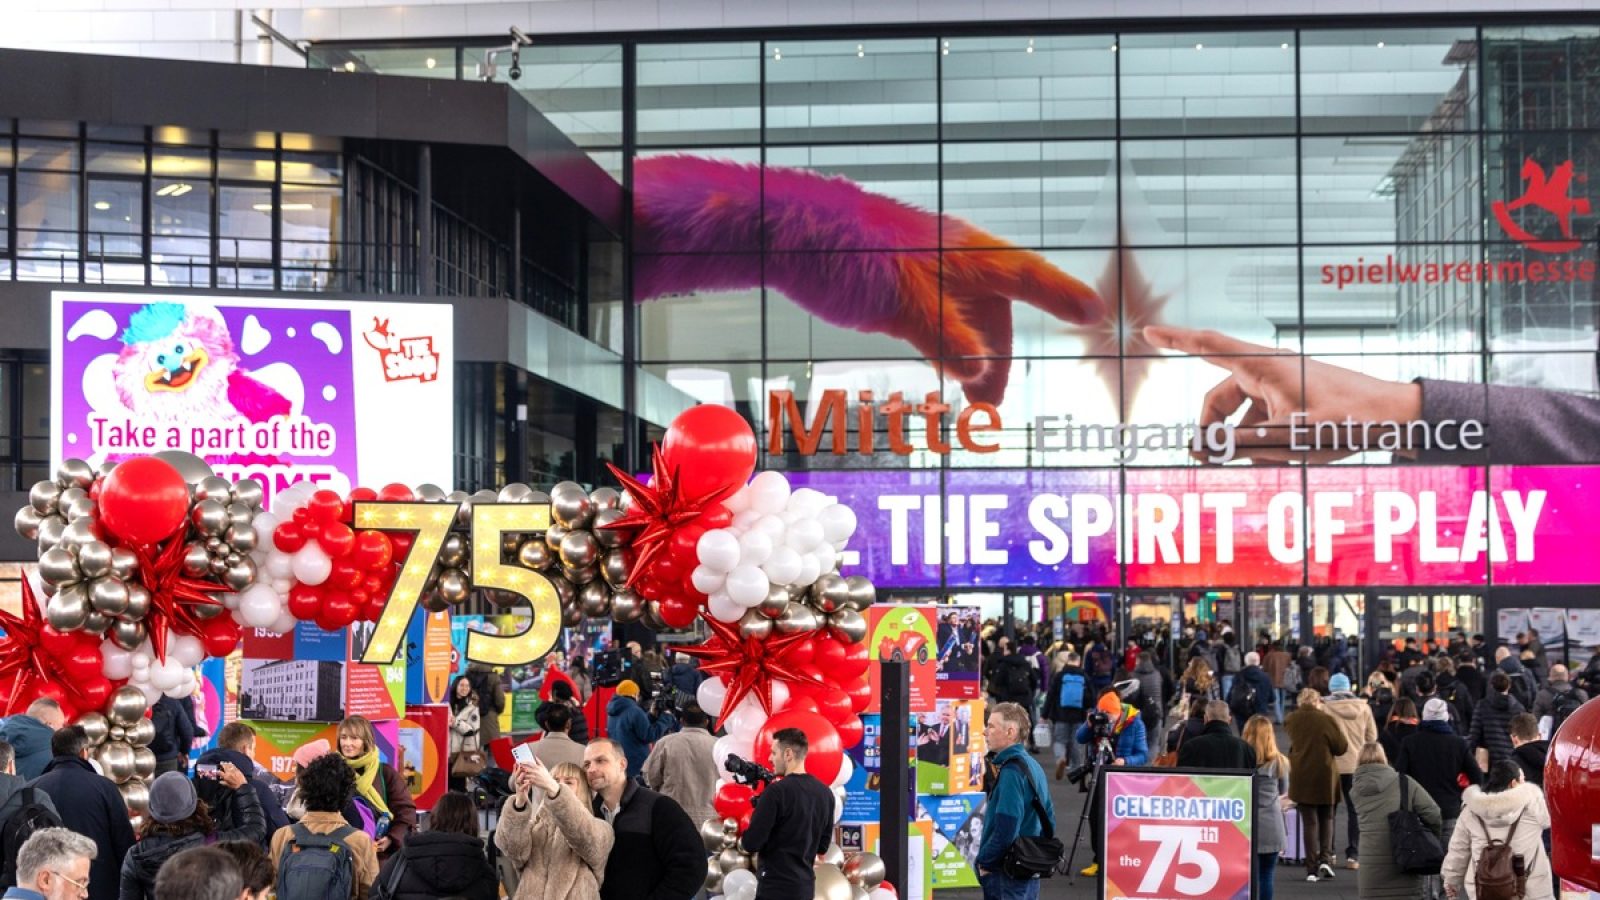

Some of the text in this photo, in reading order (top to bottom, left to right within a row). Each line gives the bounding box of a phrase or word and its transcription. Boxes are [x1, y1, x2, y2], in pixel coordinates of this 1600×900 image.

[1320, 254, 1596, 290] spielwarenmesse
[93, 418, 331, 454] Take a part of the
[769, 389, 1485, 464] Mitte Eingang Entrance
[877, 494, 1009, 565] THE
[1027, 493, 1248, 565] SPIRIT
[1267, 491, 1354, 564] OF
[1373, 489, 1548, 563] PLAY
[352, 500, 563, 666] 75
[1114, 796, 1244, 821] CELEBRATING
[1119, 855, 1142, 868] the
